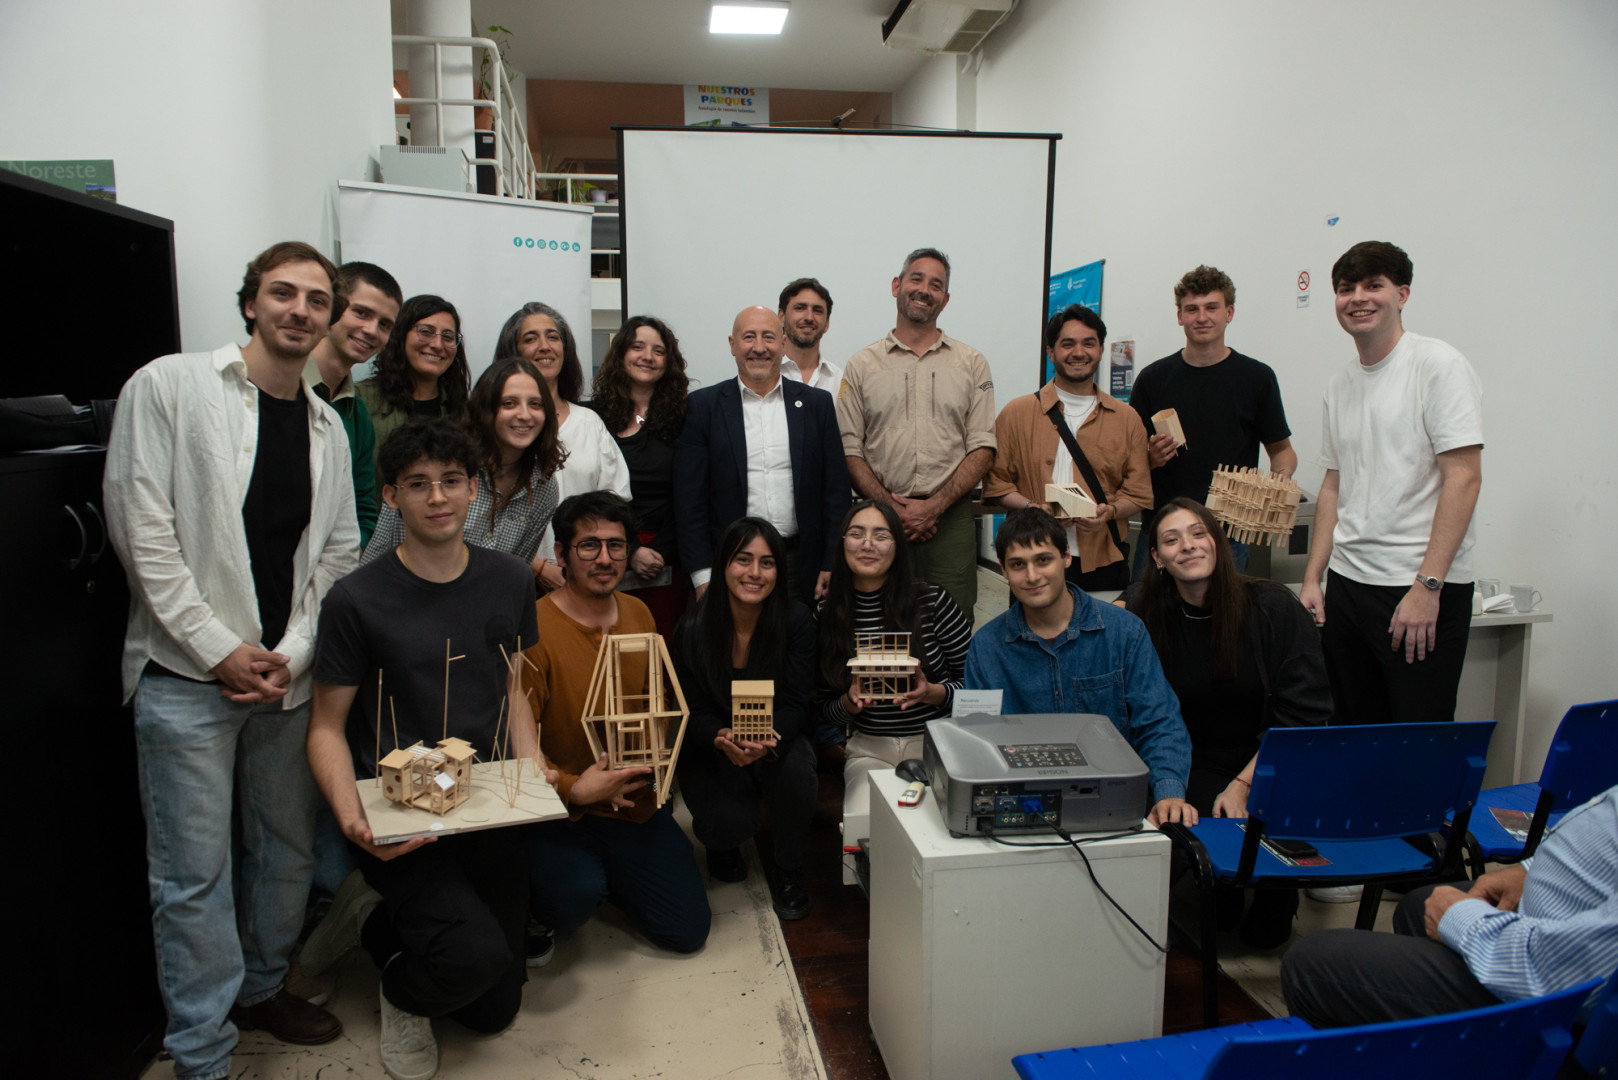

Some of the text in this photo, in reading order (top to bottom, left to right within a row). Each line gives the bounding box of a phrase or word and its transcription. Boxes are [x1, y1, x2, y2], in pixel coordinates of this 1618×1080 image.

[698, 85, 755, 96] NUESTROS
[701, 95, 752, 106] PARQUES
[8, 160, 96, 179] Noreste
